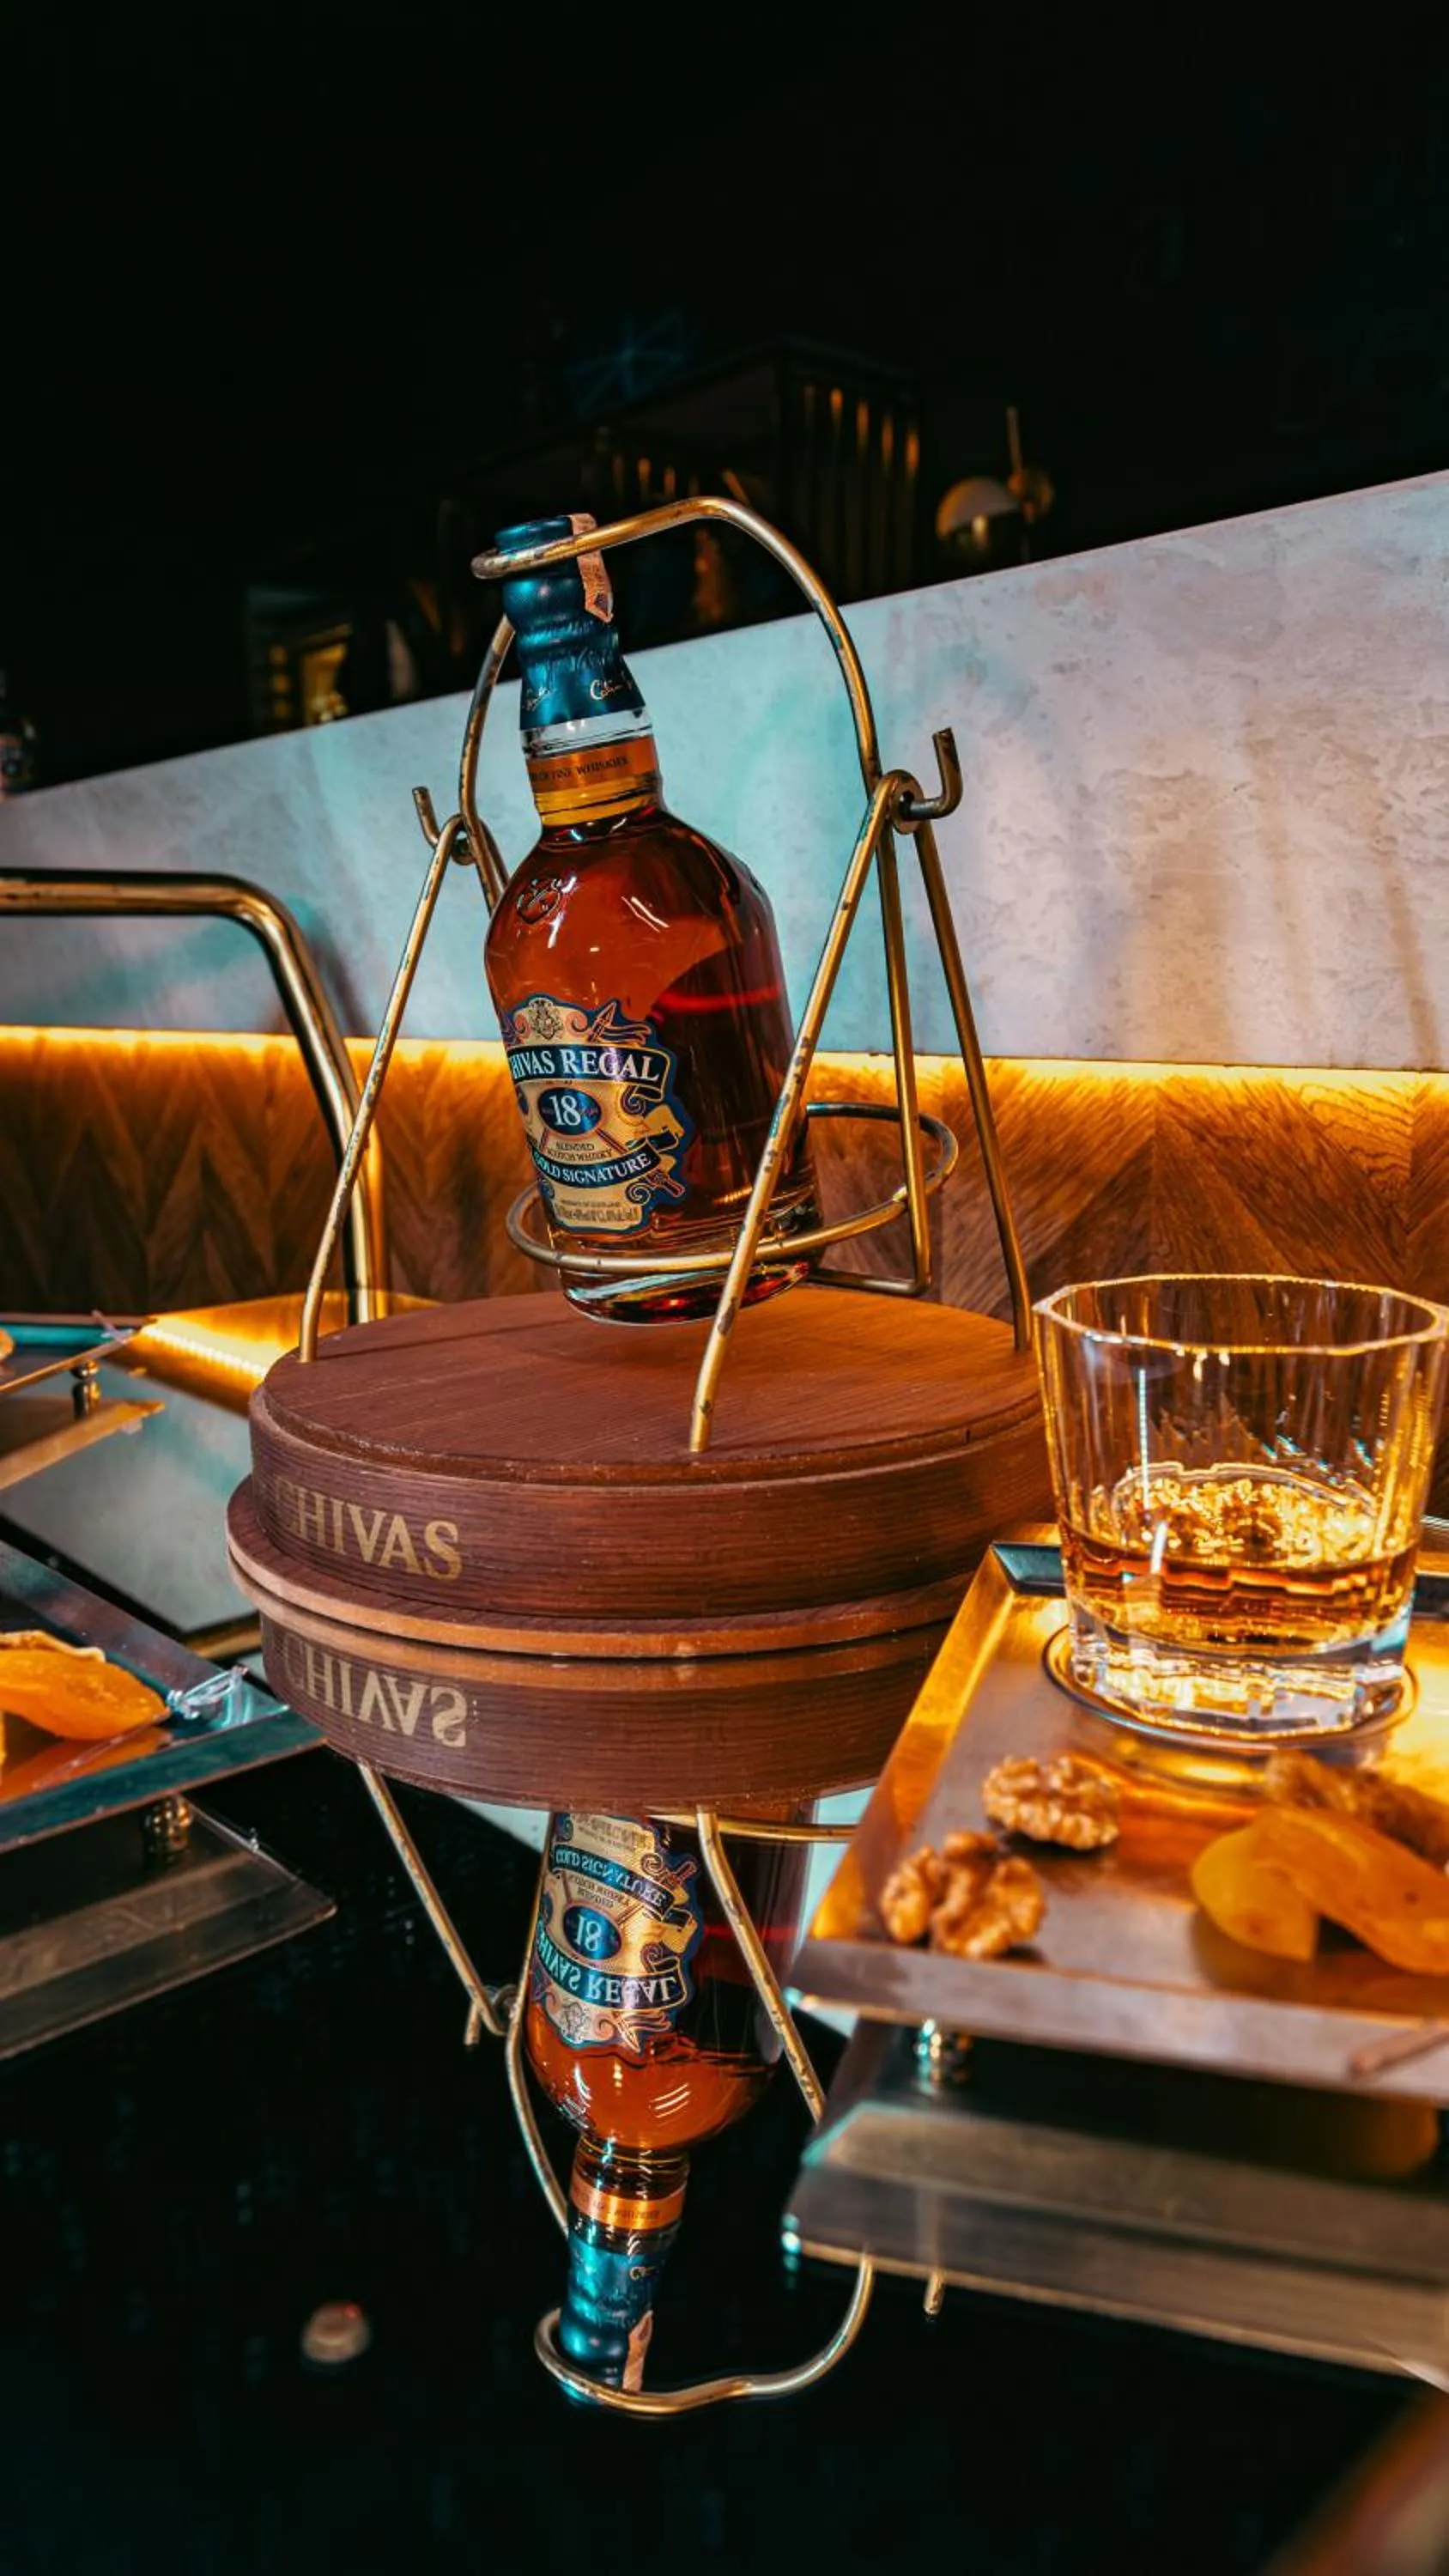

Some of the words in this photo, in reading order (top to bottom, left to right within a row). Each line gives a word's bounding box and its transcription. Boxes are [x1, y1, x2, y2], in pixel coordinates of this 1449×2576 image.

[508, 1050, 555, 1079] HIVAS
[561, 1048, 659, 1082] REGAL
[549, 1094, 582, 1127] 18
[561, 1153, 652, 1184] SIGNATURE
[275, 1475, 463, 1582] CHIVAS
